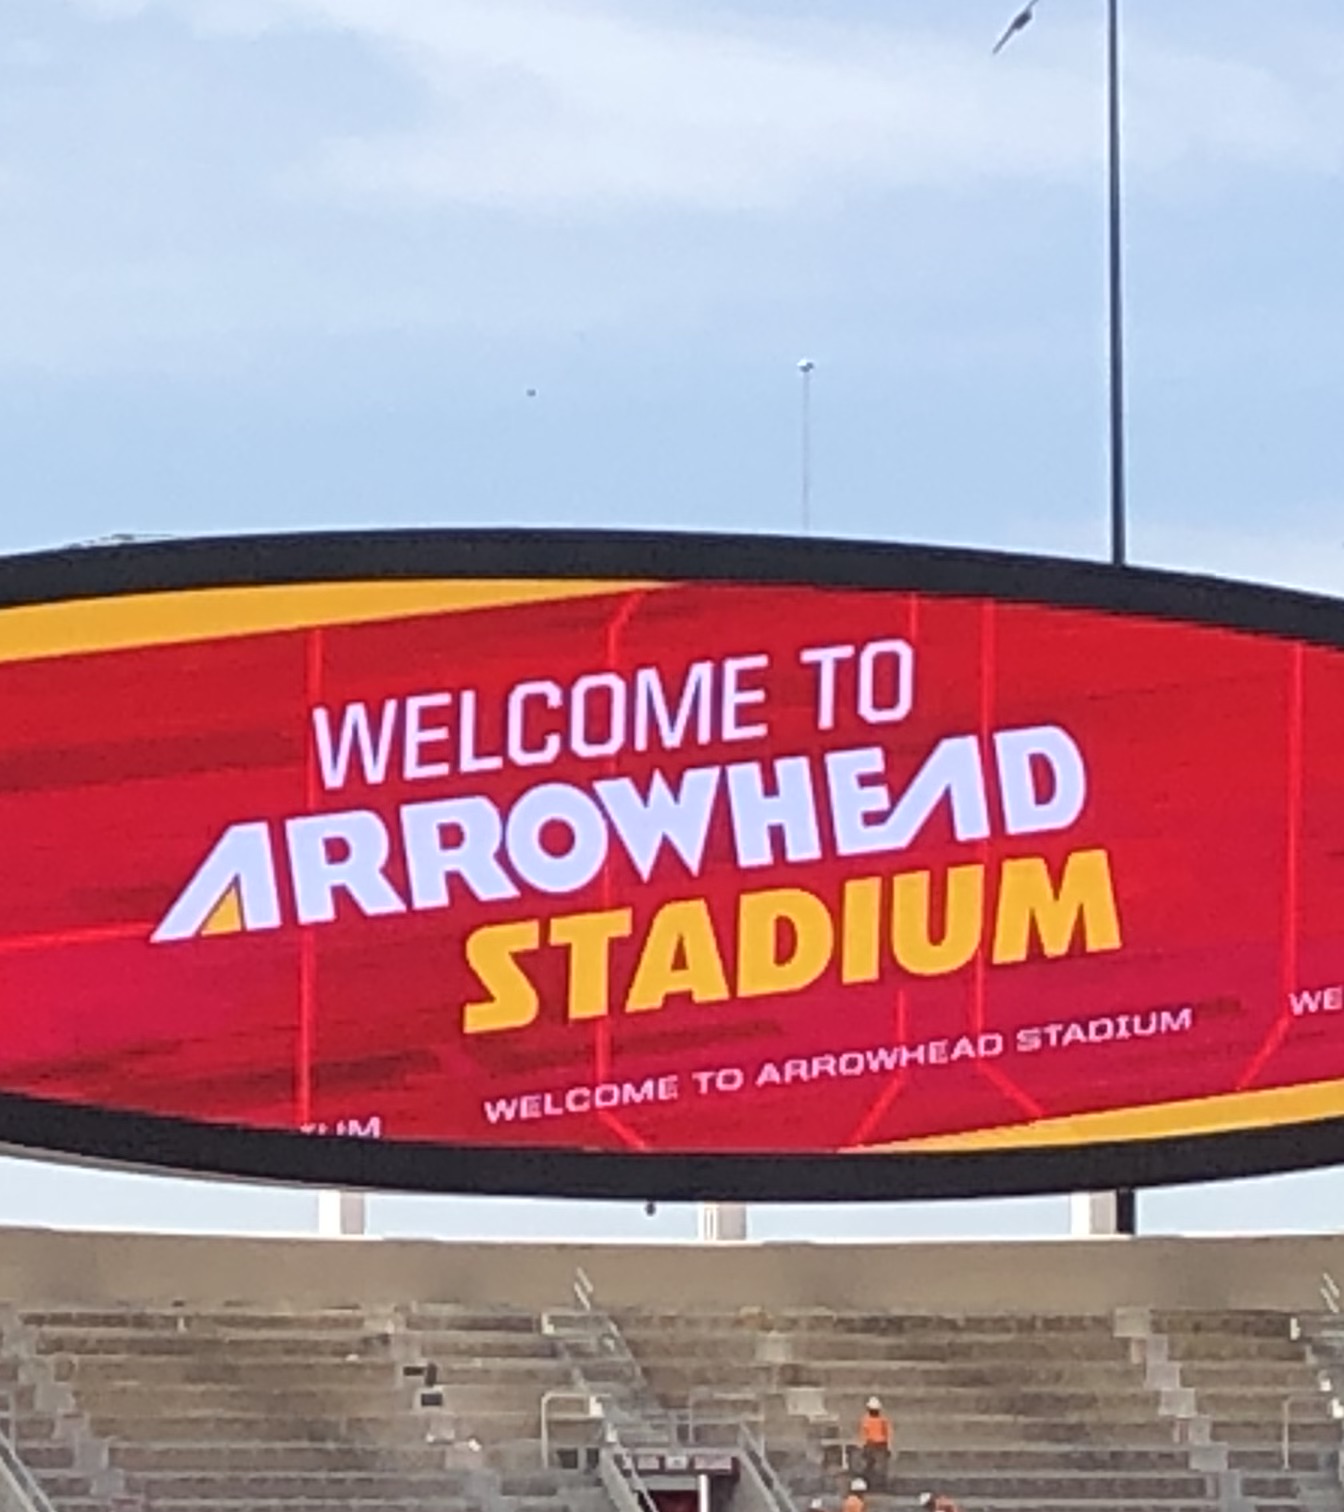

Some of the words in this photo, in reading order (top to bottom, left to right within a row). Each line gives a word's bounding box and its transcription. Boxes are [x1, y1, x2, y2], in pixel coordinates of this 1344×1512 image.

[312, 655, 770, 791] WELCOME
[800, 638, 915, 731] TO
[150, 725, 1087, 943] ARROWHEAD
[463, 849, 1122, 1033] STADIUM
[484, 1075, 678, 1124] WELCOME
[692, 1067, 743, 1094] TO
[756, 1033, 1003, 1086] ARROWHEAD
[1016, 1007, 1193, 1052] STADIUM
